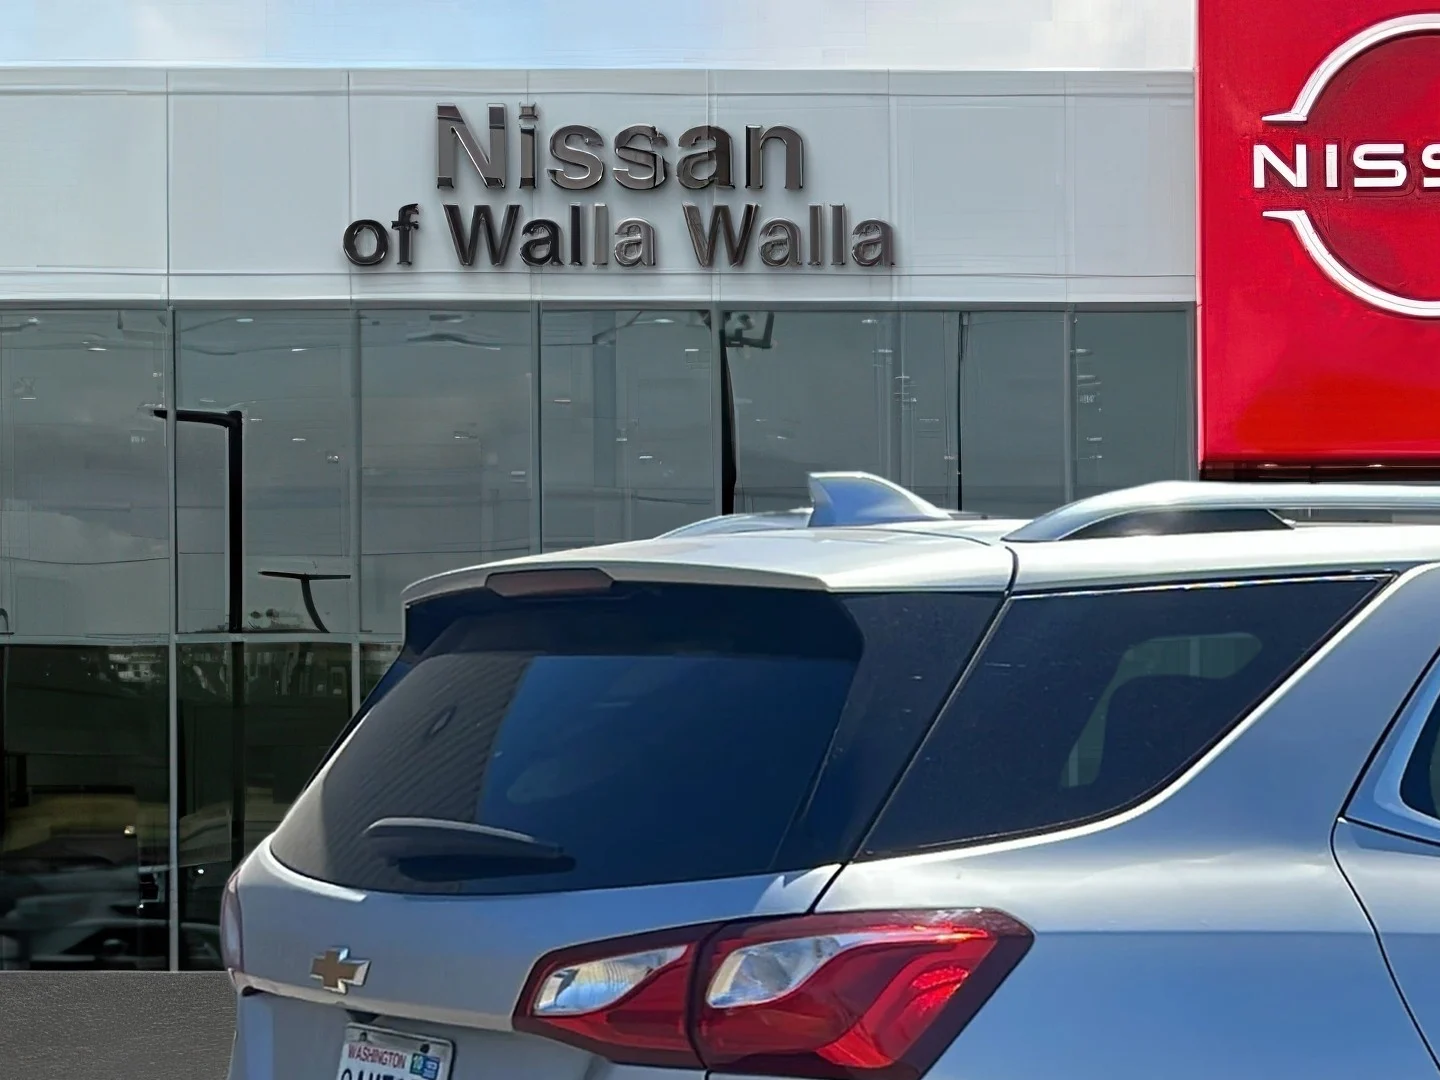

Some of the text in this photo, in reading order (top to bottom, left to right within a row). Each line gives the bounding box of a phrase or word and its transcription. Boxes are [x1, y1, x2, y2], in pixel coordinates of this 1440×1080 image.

[436, 102, 805, 190] Nissan
[342, 203, 896, 267] of Walla Walla
[347, 1043, 407, 1070] WASHINGTON
